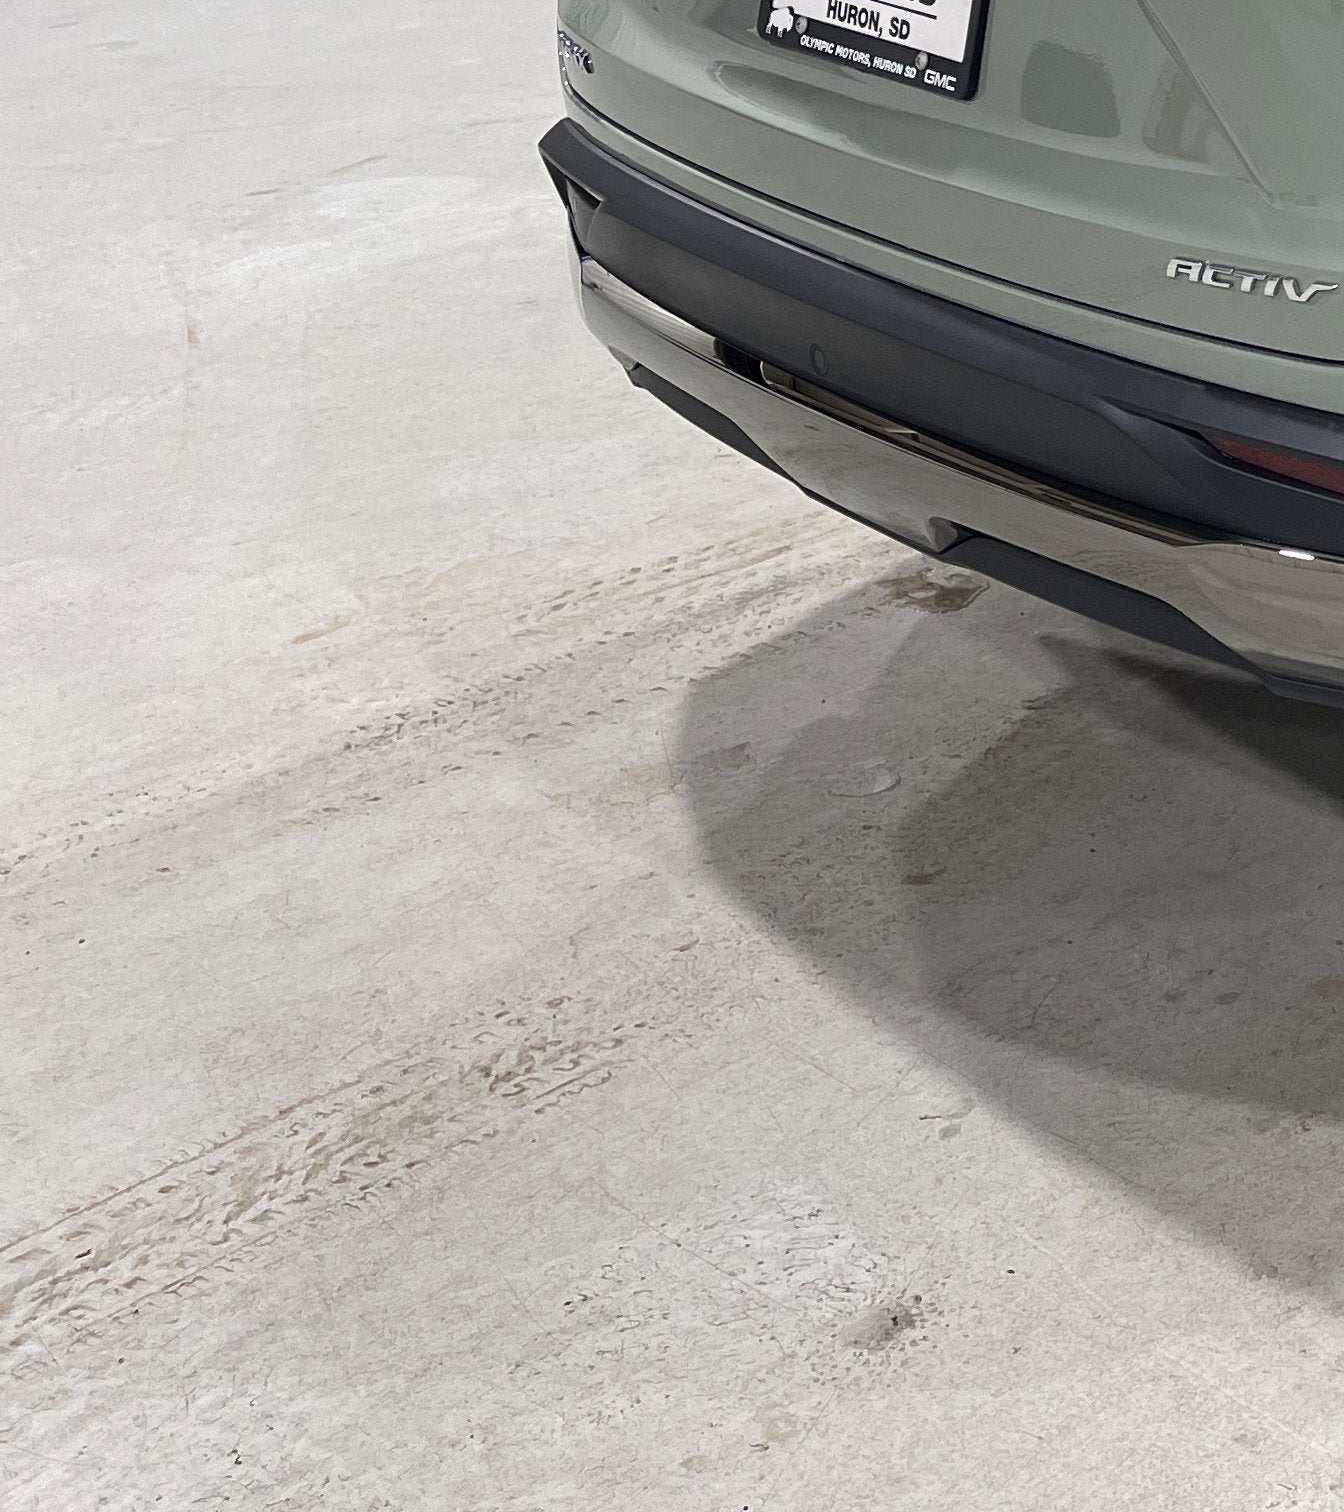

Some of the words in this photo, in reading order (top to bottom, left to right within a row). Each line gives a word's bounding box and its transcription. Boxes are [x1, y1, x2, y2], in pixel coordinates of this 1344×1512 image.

[888, 16, 911, 40] SD
[800, 34, 834, 54] OLYMPIC
[834, 44, 871, 68] MOTORS,
[872, 56, 903, 75] HURON
[903, 66, 917, 79] SD
[923, 69, 957, 92] GMC
[1166, 257, 1339, 303] ACTIV
